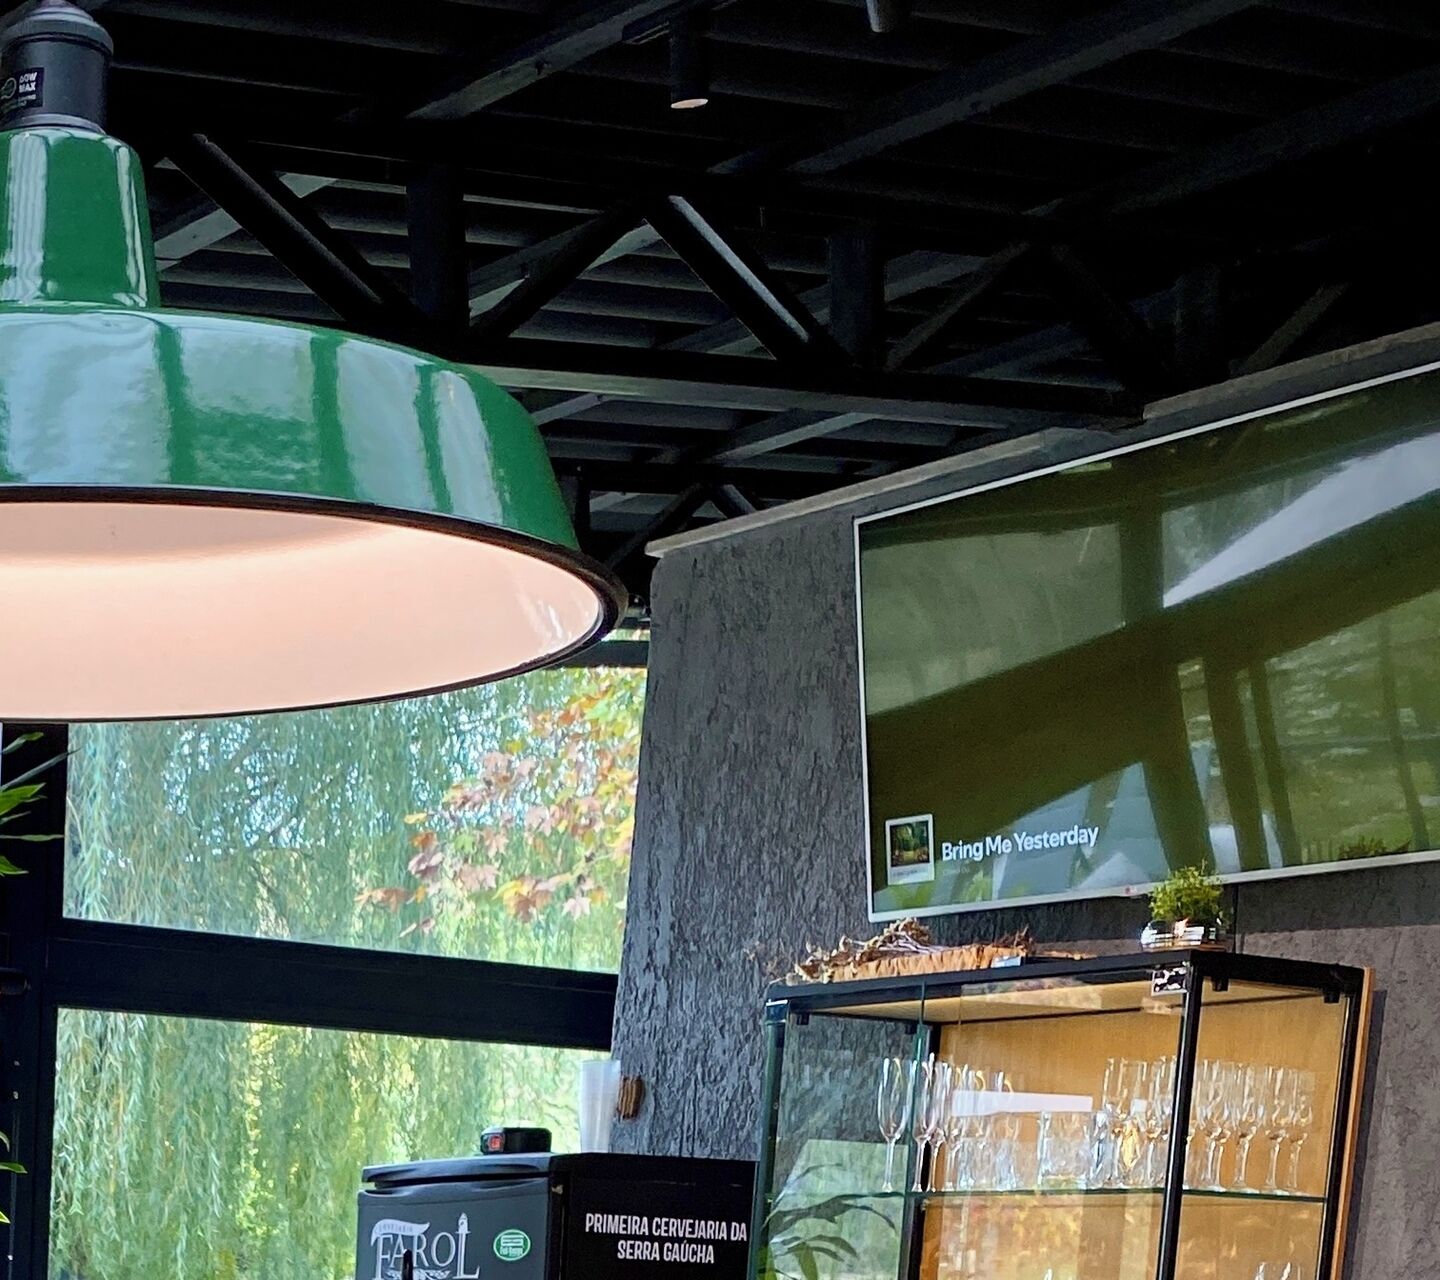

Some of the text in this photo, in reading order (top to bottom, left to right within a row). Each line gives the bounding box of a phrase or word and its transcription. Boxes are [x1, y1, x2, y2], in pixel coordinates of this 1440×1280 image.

[941, 825, 1099, 861] Bring Me Yesterday
[585, 1213, 747, 1241] PRIMEIRA CERVEJARIA DA
[617, 1240, 715, 1264] SERRA GAÚCHA
